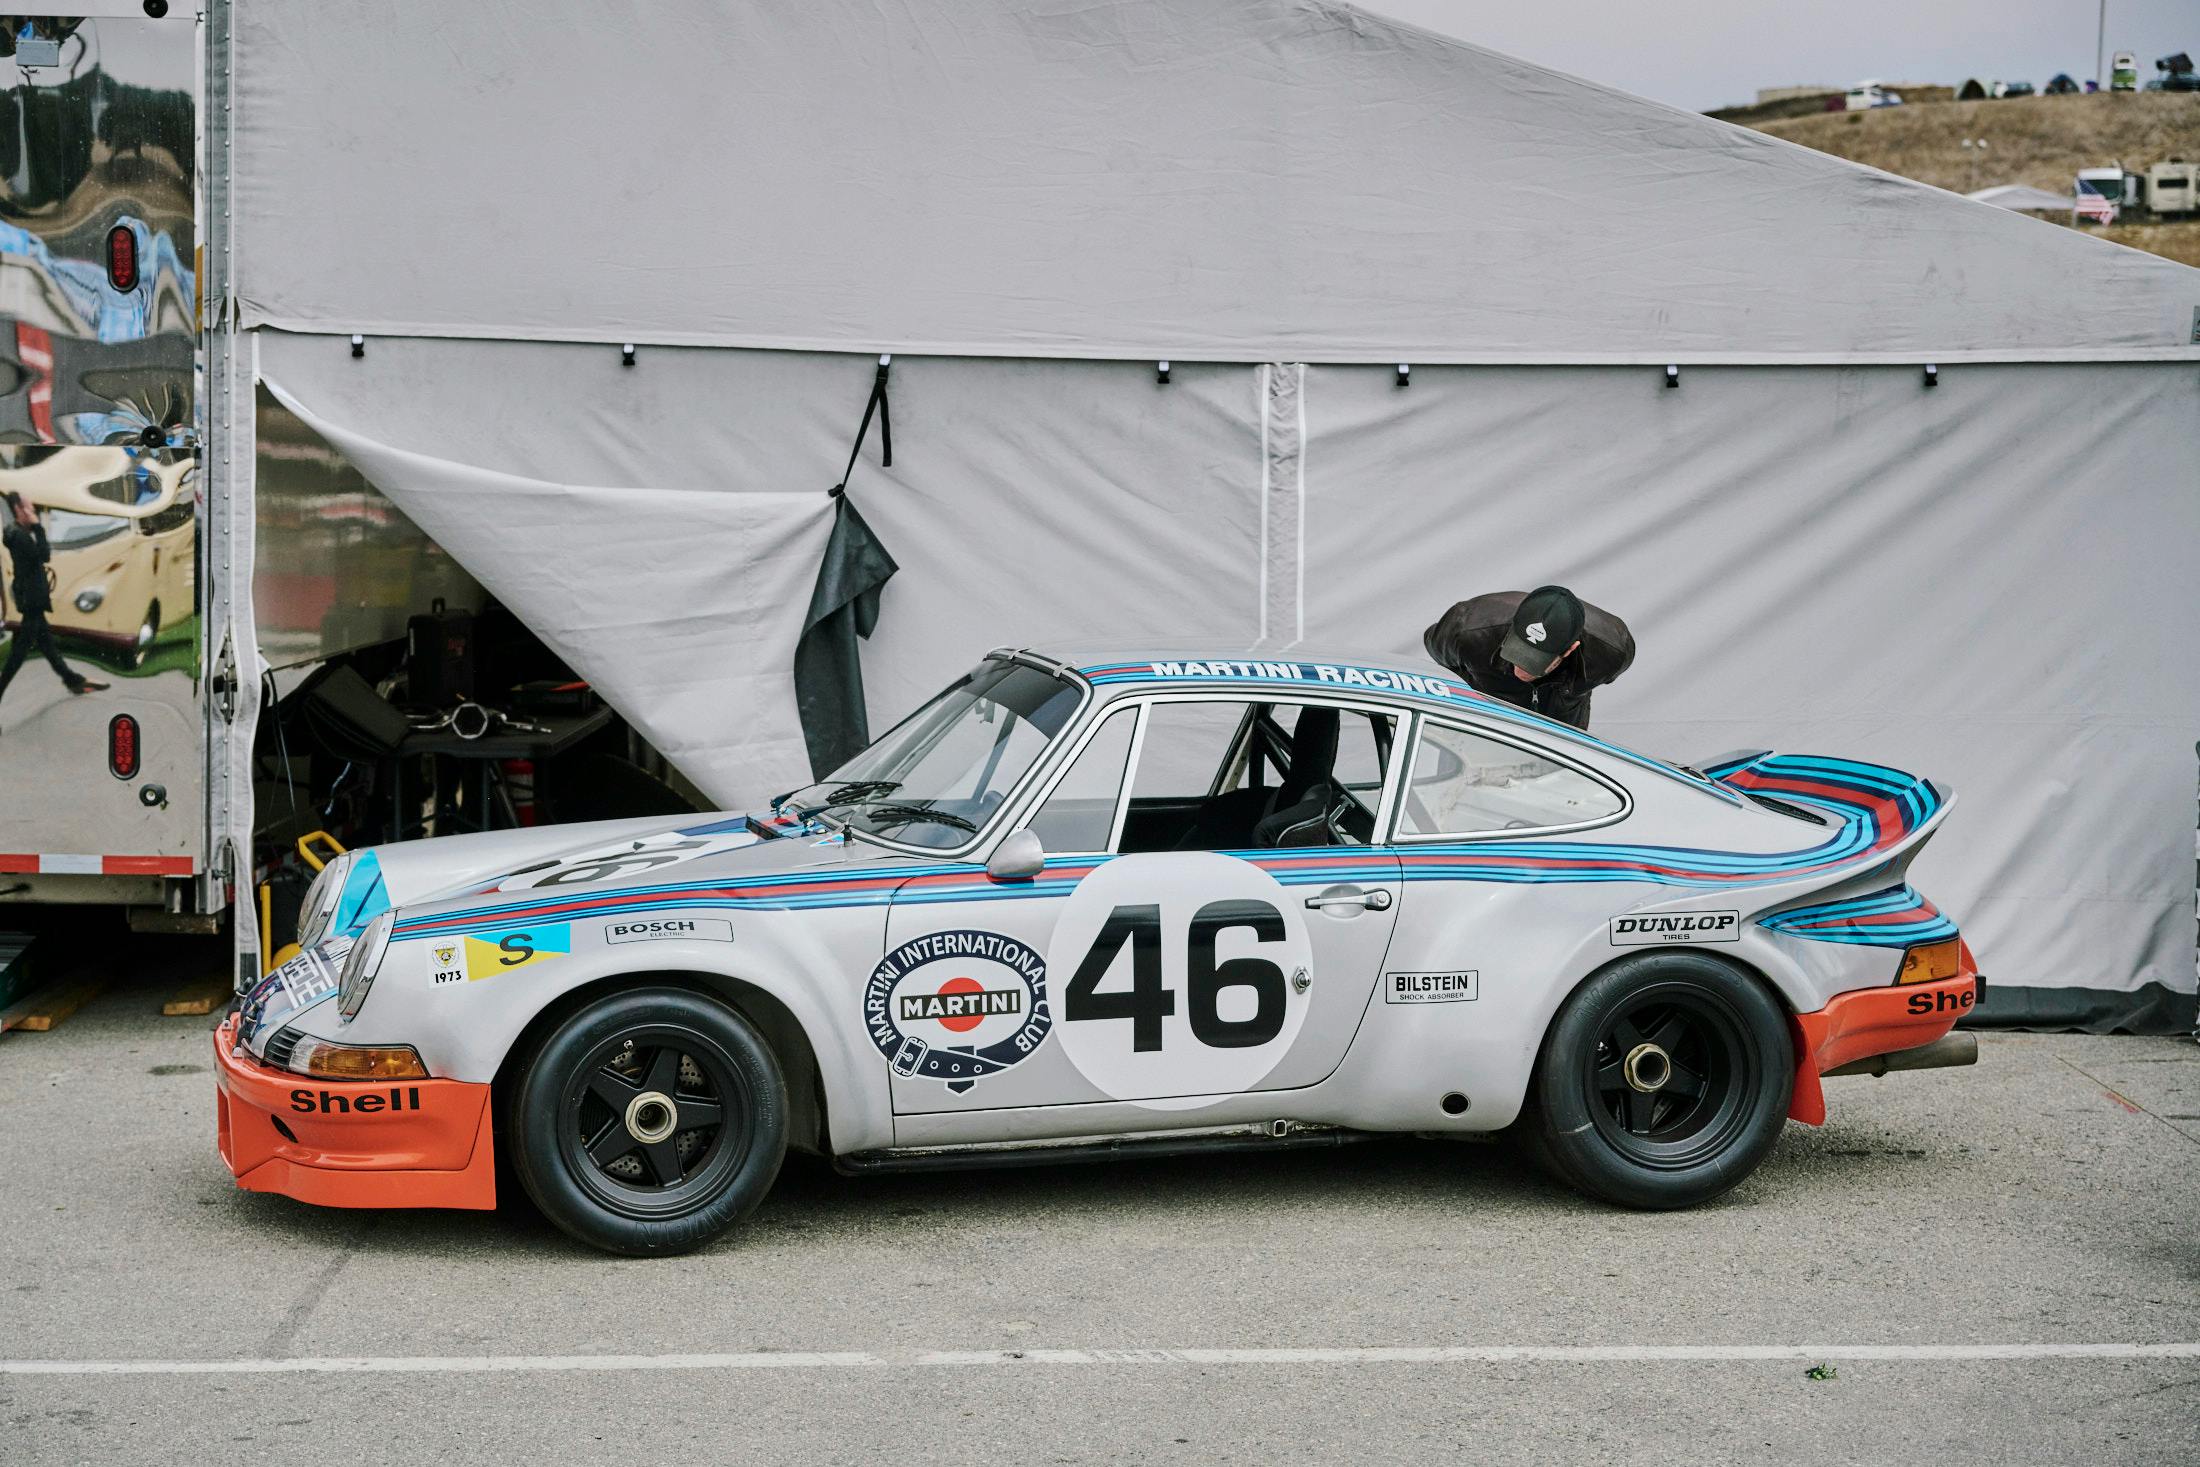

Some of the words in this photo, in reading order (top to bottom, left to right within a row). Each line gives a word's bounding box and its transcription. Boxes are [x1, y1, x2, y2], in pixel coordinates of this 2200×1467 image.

[1151, 661, 1304, 680] MARTINI
[1313, 665, 1451, 698] RACING
[614, 921, 695, 936] BOSCH
[1615, 915, 1735, 934] DUNLOP
[1662, 933, 1691, 941] TIRES
[499, 933, 534, 966] S
[435, 970, 462, 984] 1973
[1066, 899, 1287, 1053] 46
[1395, 974, 1468, 992] BILSTEIN
[868, 961, 901, 1047] MARTINI
[897, 933, 1045, 995] INTERNATIONAL
[1014, 999, 1052, 1052] CLUB
[1427, 992, 1464, 1000] ABSORBER
[903, 992, 1018, 1018] MARTINI
[290, 1087, 420, 1114] Shell
